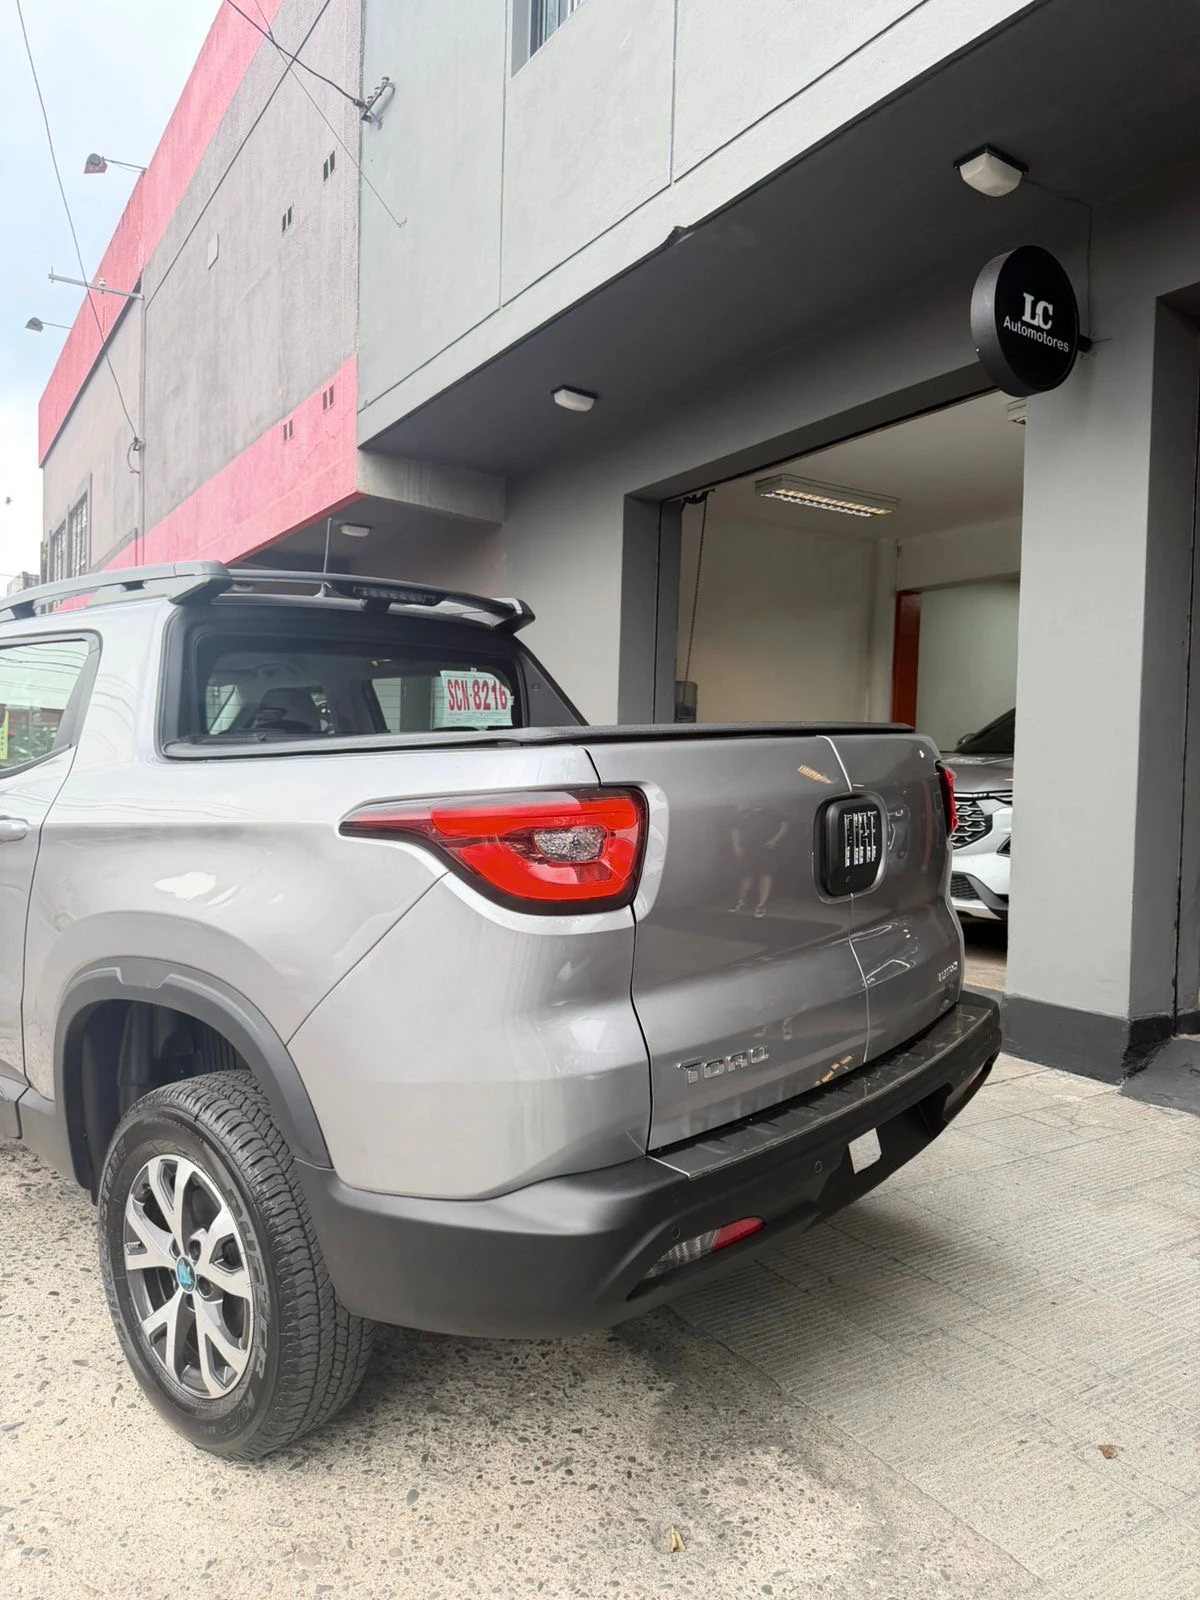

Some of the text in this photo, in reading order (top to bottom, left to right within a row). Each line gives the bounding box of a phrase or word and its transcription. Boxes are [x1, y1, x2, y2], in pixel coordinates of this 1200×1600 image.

[1022, 292, 1053, 330] LC
[1003, 315, 1069, 353] Automotores
[676, 1045, 770, 1084] TORO
